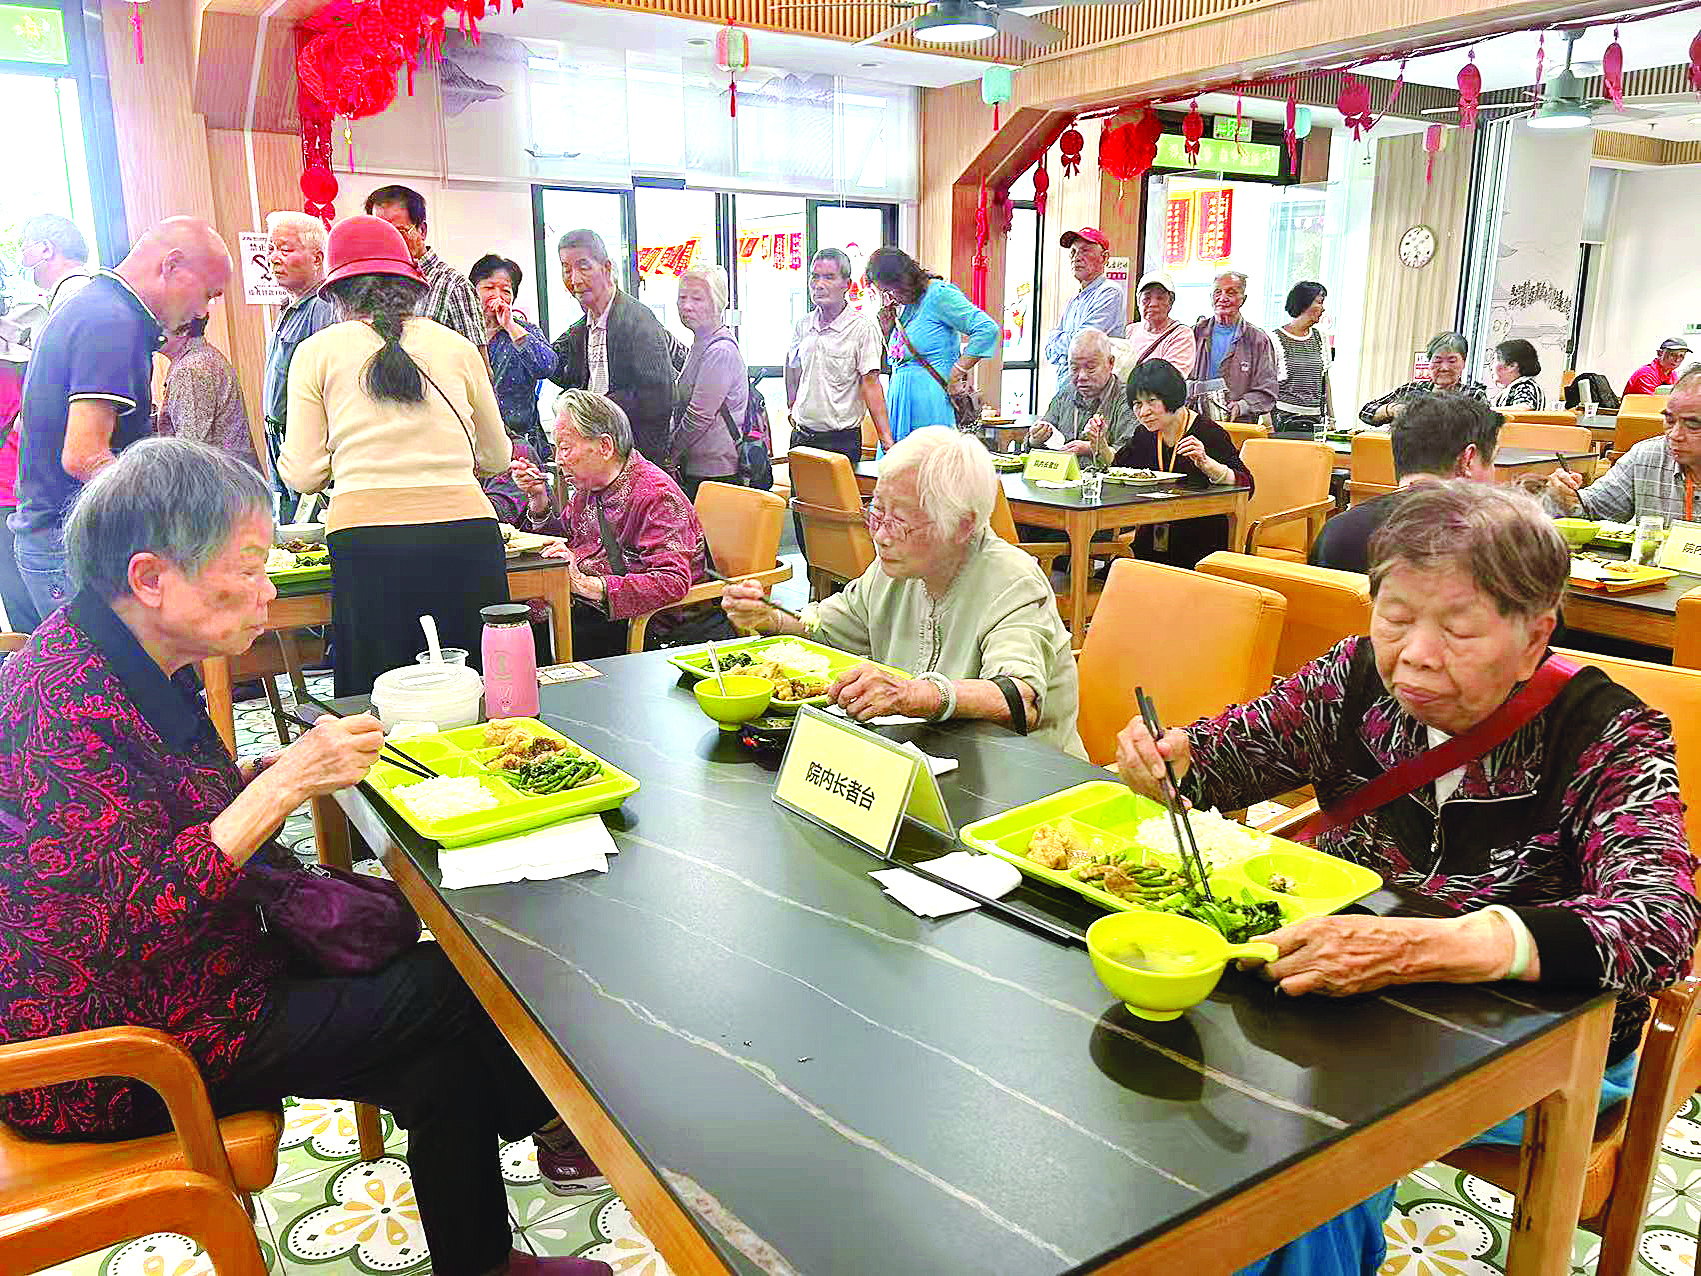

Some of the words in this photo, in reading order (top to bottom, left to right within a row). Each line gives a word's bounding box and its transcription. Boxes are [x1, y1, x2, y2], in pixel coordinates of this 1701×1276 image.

[804, 761, 876, 811] 院内长者台
